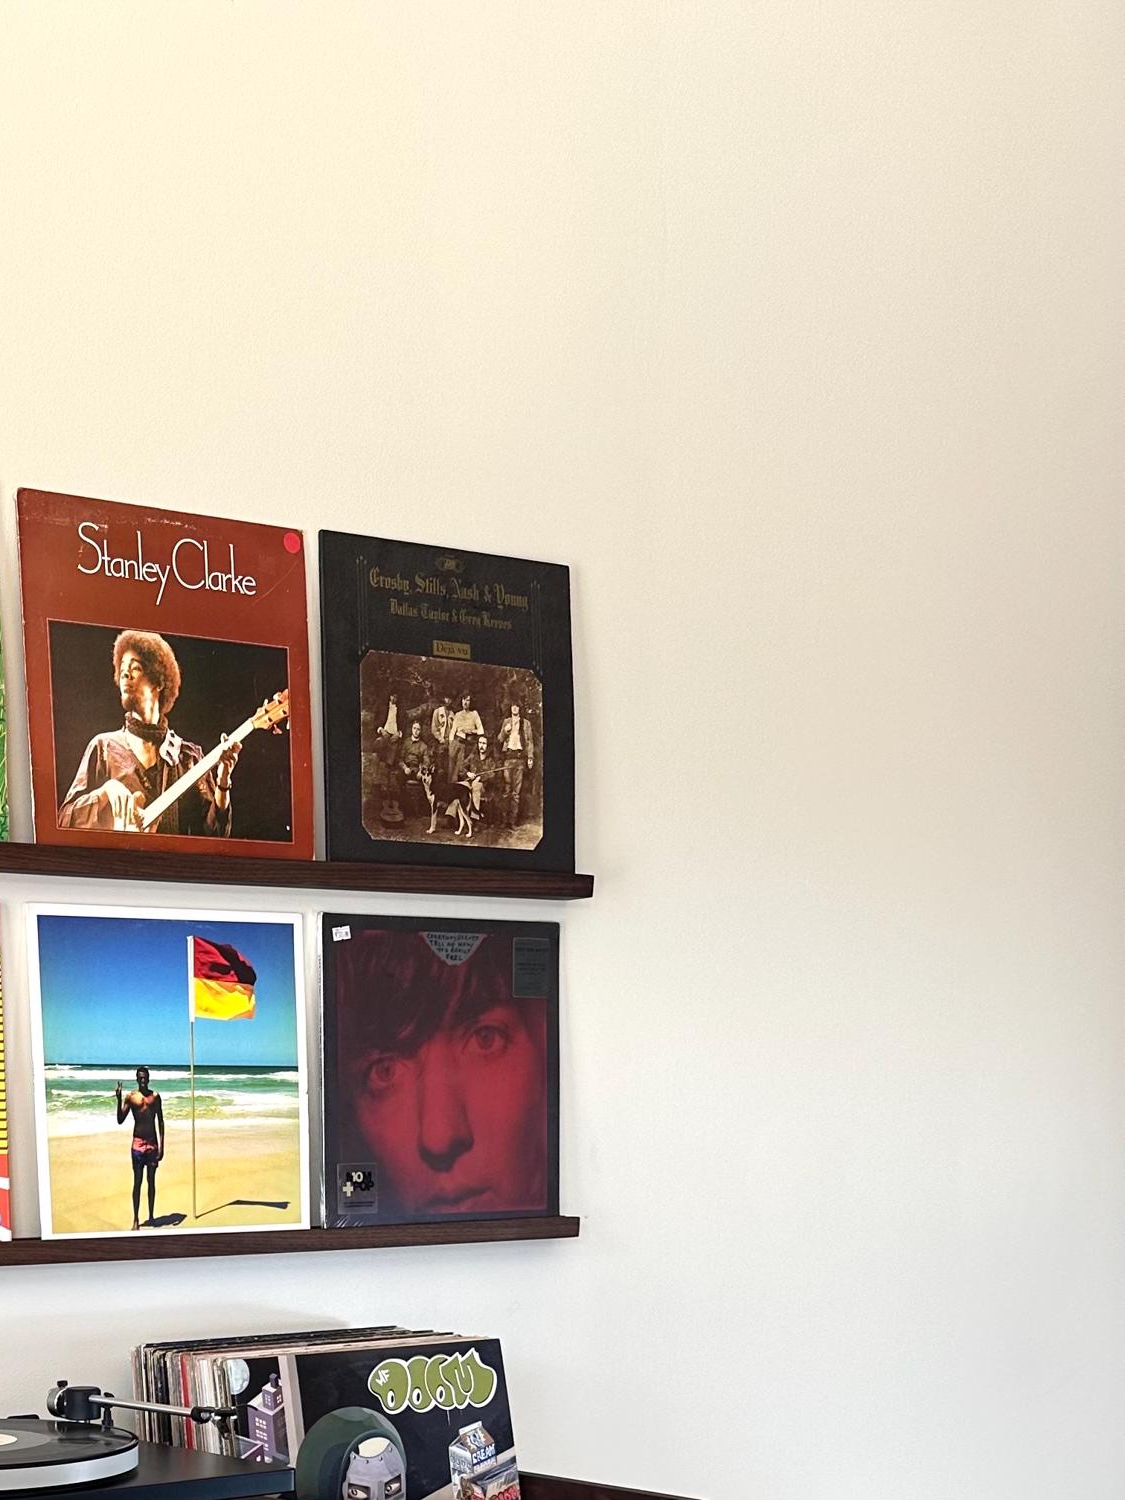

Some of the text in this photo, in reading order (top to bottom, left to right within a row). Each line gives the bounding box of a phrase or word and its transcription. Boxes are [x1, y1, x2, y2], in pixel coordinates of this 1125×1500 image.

[77, 521, 257, 605] Stanley Clarke
[375, 1368, 390, 1387] MF
